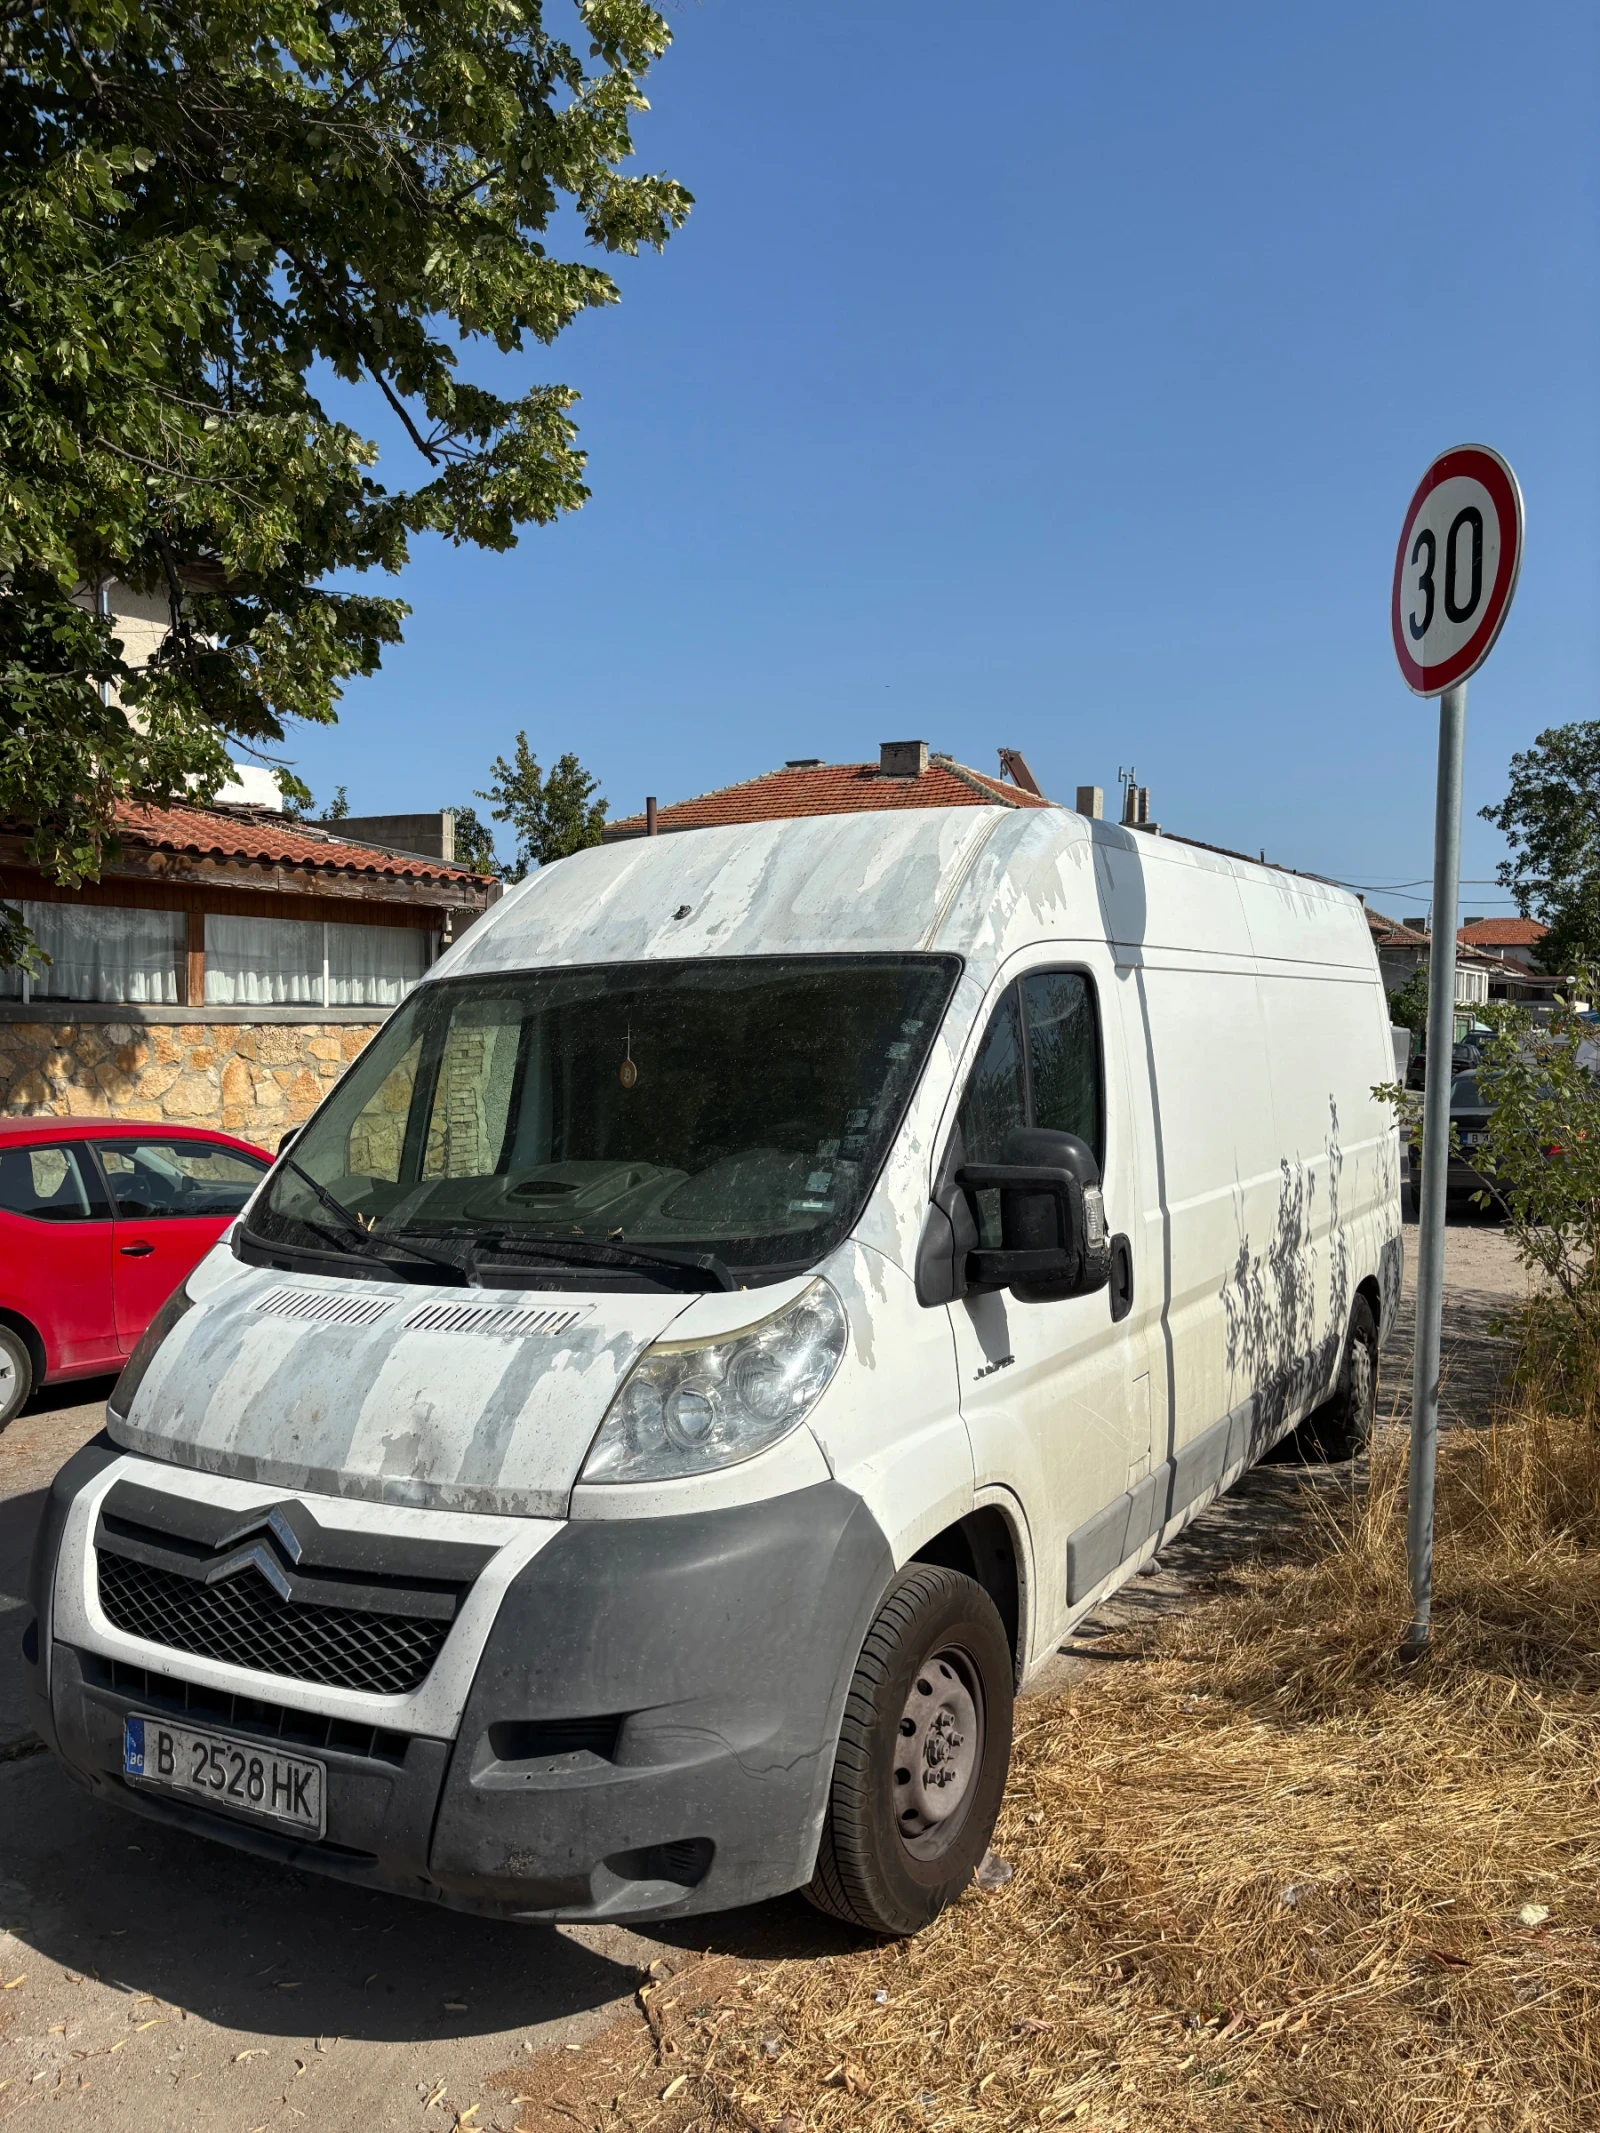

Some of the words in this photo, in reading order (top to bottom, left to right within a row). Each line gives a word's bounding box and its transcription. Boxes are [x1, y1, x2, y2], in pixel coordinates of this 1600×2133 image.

[1409, 506, 1483, 640] 30
[130, 1752, 143, 1766] BG
[158, 1731, 175, 1775] B
[191, 1742, 265, 1801] 2528
[272, 1762, 313, 1818] HK
